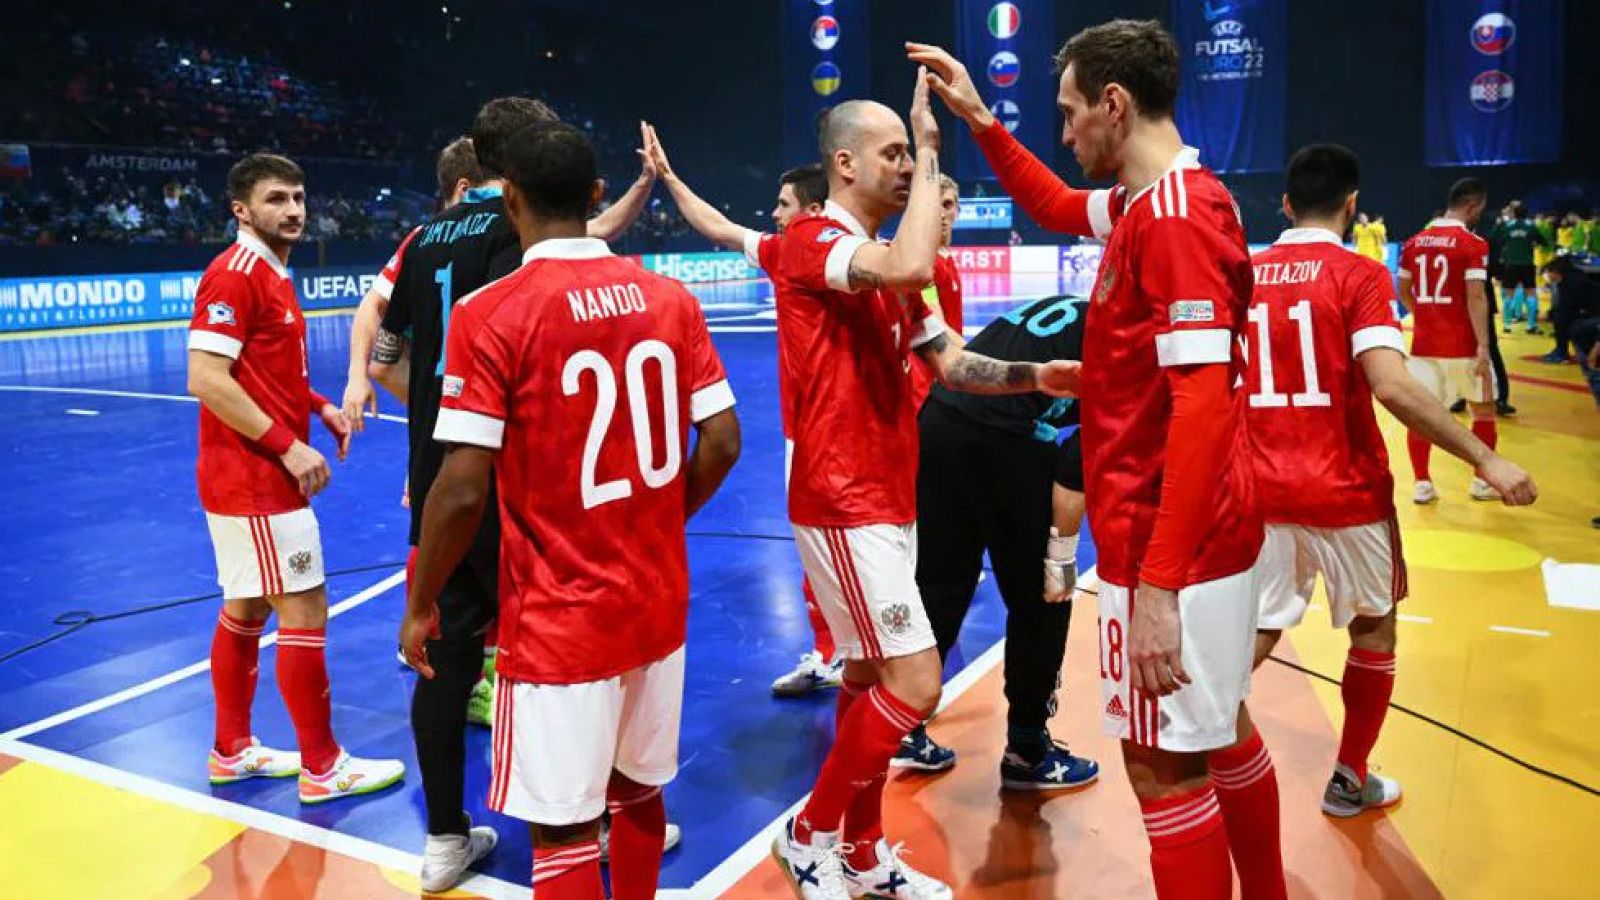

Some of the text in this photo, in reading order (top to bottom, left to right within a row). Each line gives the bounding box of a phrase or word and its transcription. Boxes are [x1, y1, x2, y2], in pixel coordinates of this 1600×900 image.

[85, 154, 197, 171] AMSTERDAM
[655, 253, 748, 283] Hisense
[1414, 254, 1453, 304] 12
[19, 279, 145, 310] MONDO
[566, 282, 647, 322] NANDO
[1003, 298, 1080, 338] 16
[1247, 299, 1332, 408] 11
[561, 339, 681, 509] 20
